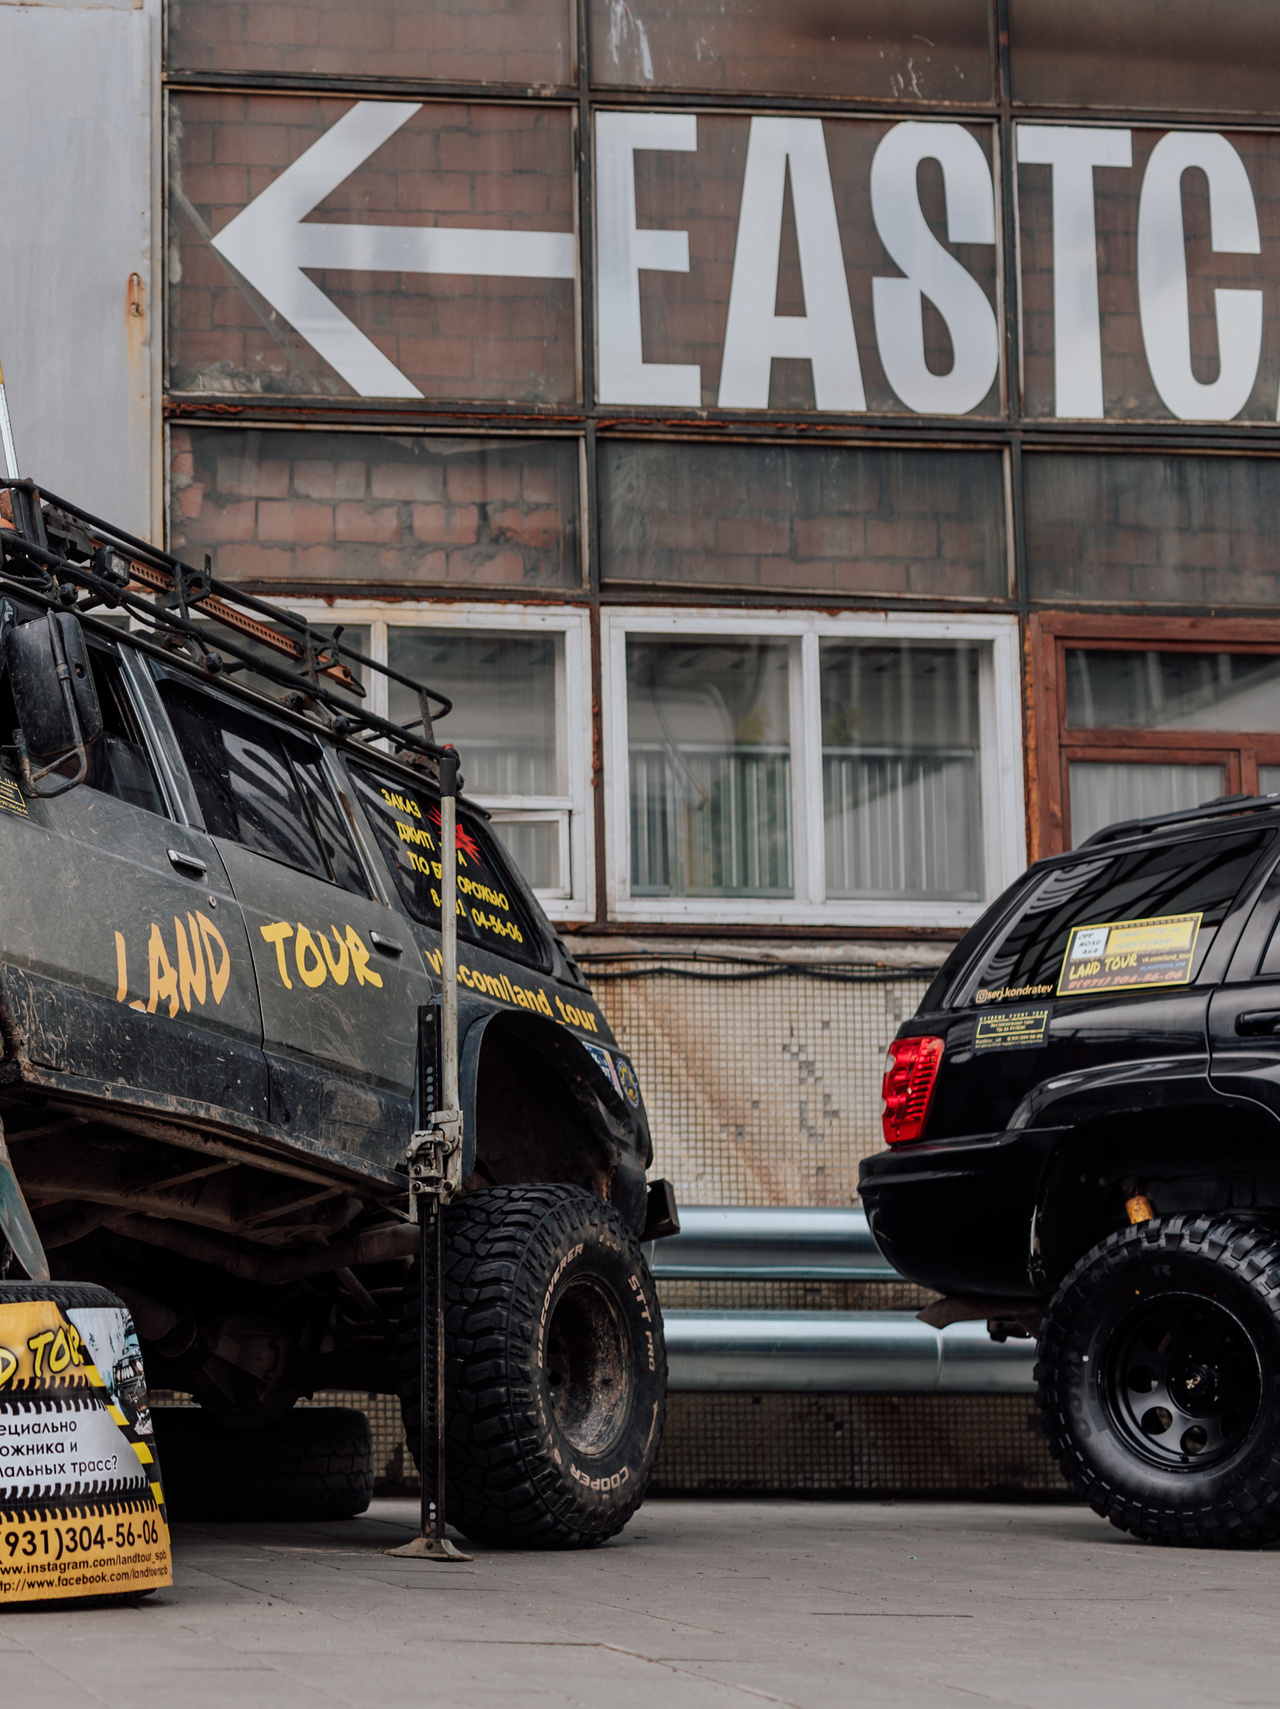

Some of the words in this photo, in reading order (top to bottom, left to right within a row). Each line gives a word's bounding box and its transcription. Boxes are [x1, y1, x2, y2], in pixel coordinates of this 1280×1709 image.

[595, 110, 1280, 421] EASTC
[381, 788, 422, 818] ЗАКАЗ
[395, 820, 435, 851] ДЖИП
[407, 850, 430, 876] ПО
[431, 860, 509, 911] БОРОЖЬЮ
[114, 910, 231, 1020] LAND
[259, 920, 384, 990] TOUR
[1069, 961, 1101, 980] LAND
[1105, 952, 1138, 973] TOUR
[424, 947, 599, 1032] v.com/land_tour
[70, 1441, 78, 1453] и
[70, 1455, 118, 1476] трасс?
[570, 1464, 631, 1492] COOPER
